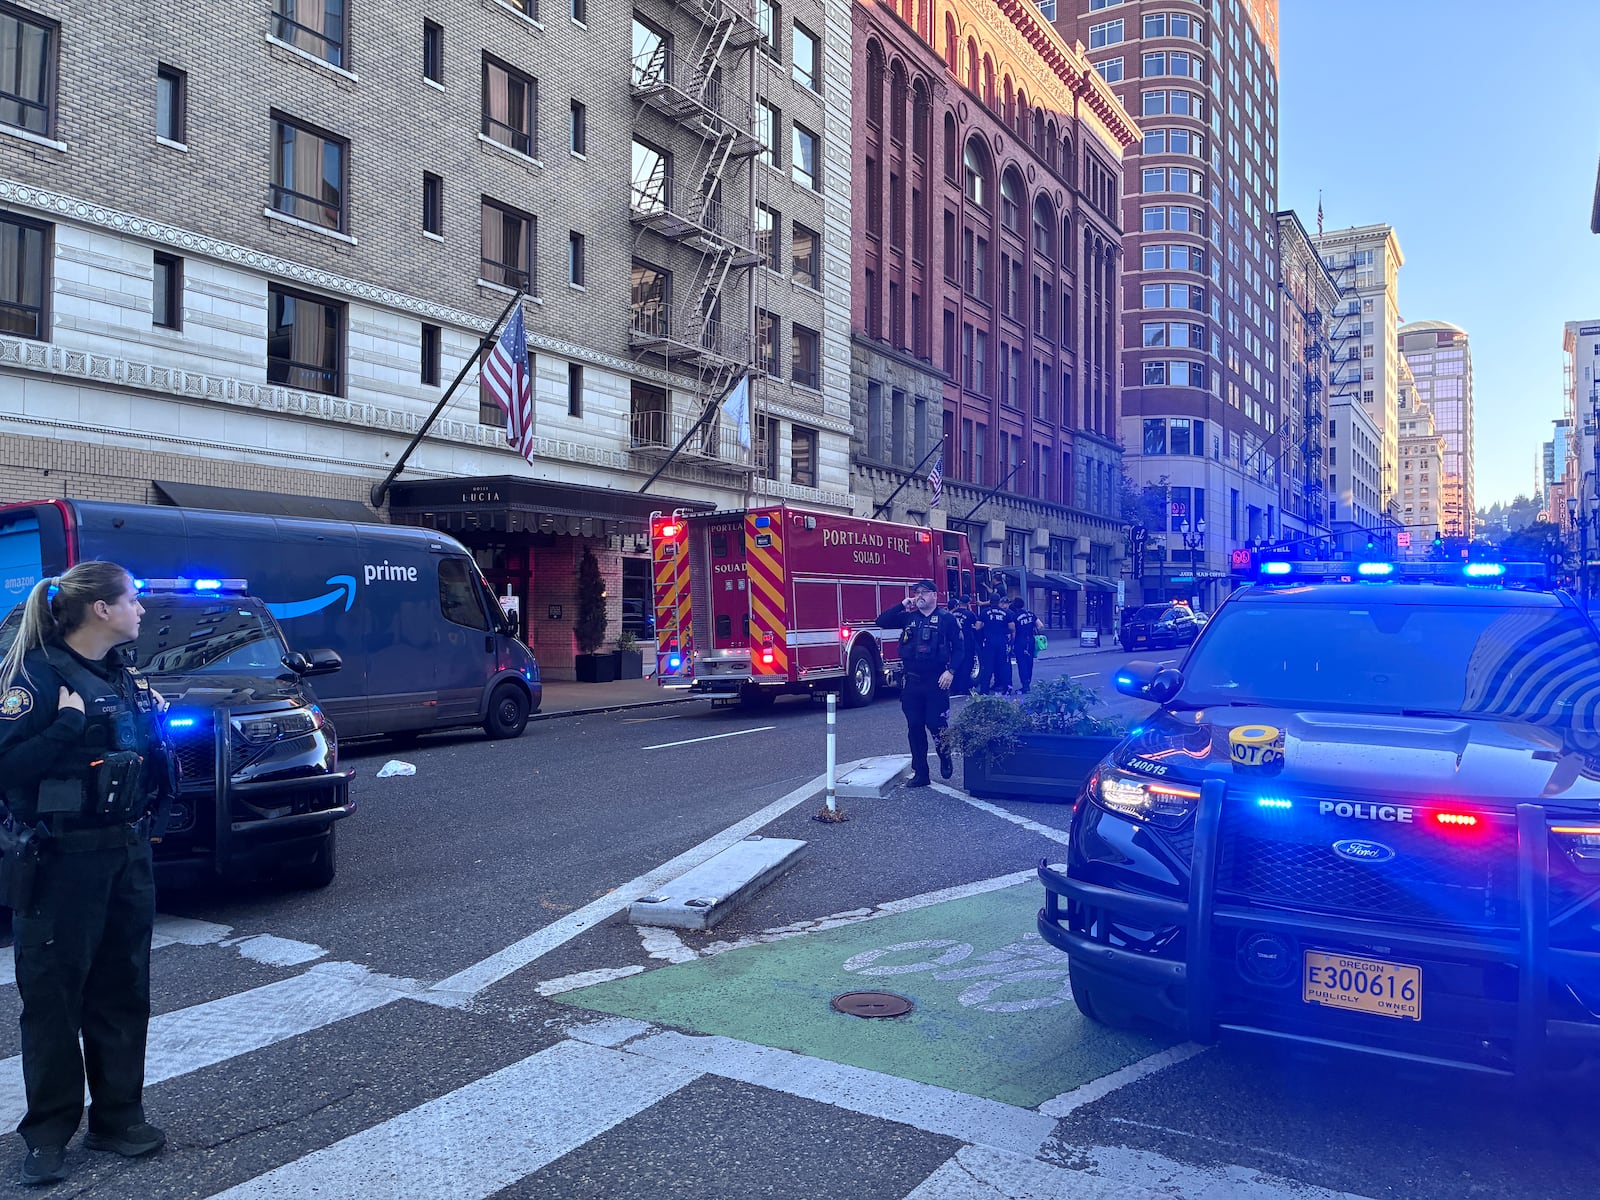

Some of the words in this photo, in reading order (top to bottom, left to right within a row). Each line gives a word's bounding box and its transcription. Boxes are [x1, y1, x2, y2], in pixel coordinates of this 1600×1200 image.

[462, 492, 500, 502] LUCIA
[711, 523, 743, 532] PORTLA
[823, 529, 883, 547] PORTLAND
[887, 537, 910, 555] FIRE
[853, 550, 880, 564] SQUAD
[882, 554, 886, 565] 1
[364, 560, 418, 585] prime
[714, 563, 747, 573] SQUAD
[5, 576, 35, 588] amazon
[1127, 758, 1168, 775] 240015
[1319, 800, 1413, 823] POLICE
[1346, 842, 1380, 858] Ford
[1339, 960, 1384, 973] OREGON
[1309, 966, 1415, 1001] E300616
[1308, 989, 1359, 1003] PUBLICLY
[1377, 1001, 1415, 1012] OWNED
